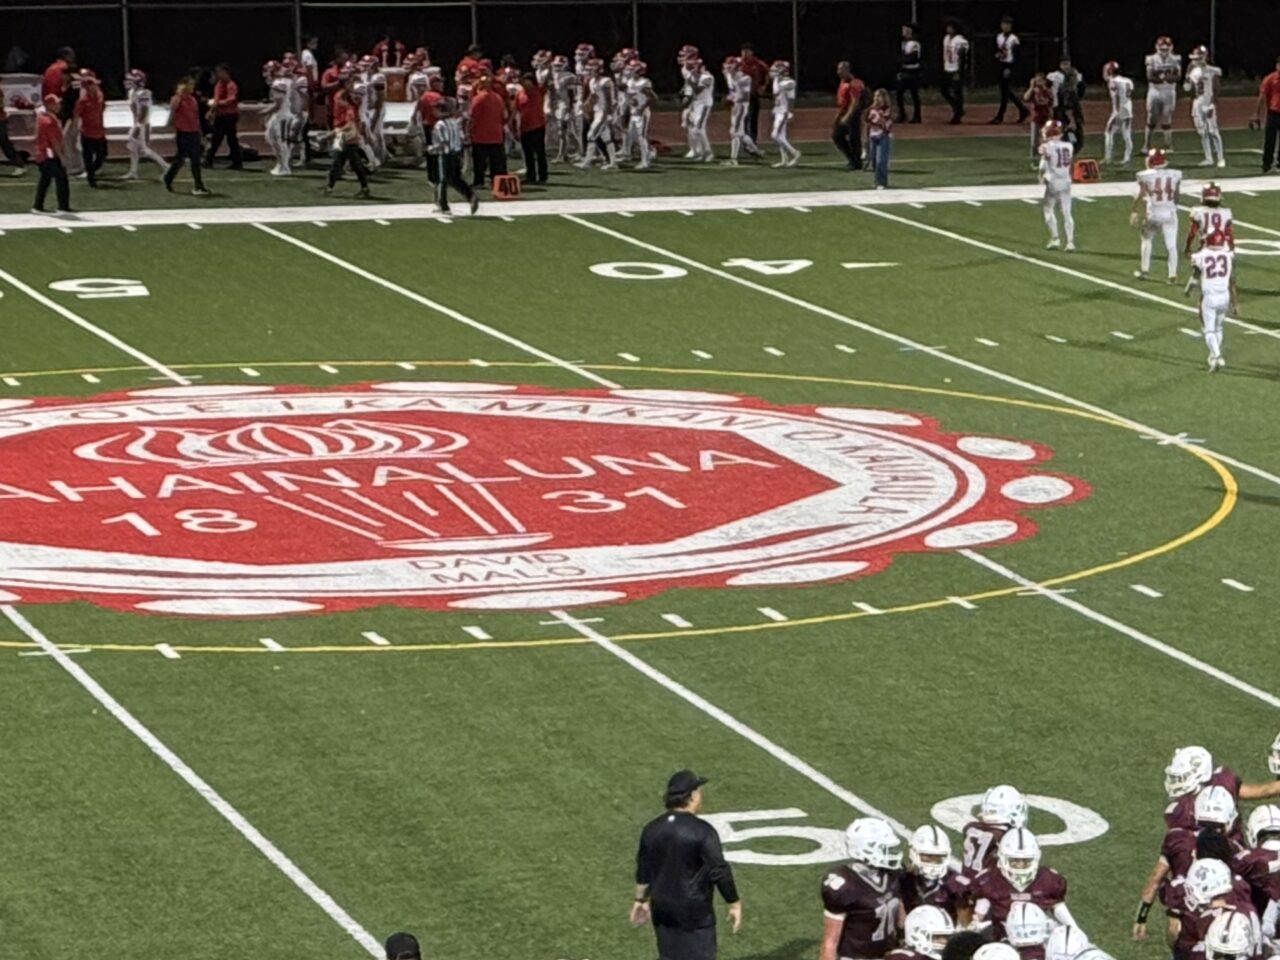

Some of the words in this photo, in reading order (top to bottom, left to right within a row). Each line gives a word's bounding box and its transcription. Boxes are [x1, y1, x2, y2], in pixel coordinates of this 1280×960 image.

[498, 176, 520, 196] 40
[1151, 177, 1175, 202] 44
[1204, 254, 1229, 279] 23
[70, 401, 227, 420] OLE
[344, 397, 443, 411] KA
[482, 400, 787, 431] MAKANI
[101, 507, 258, 537] 18
[540, 484, 687, 514] 31
[407, 550, 571, 571] DAVID
[431, 564, 588, 586] MALO
